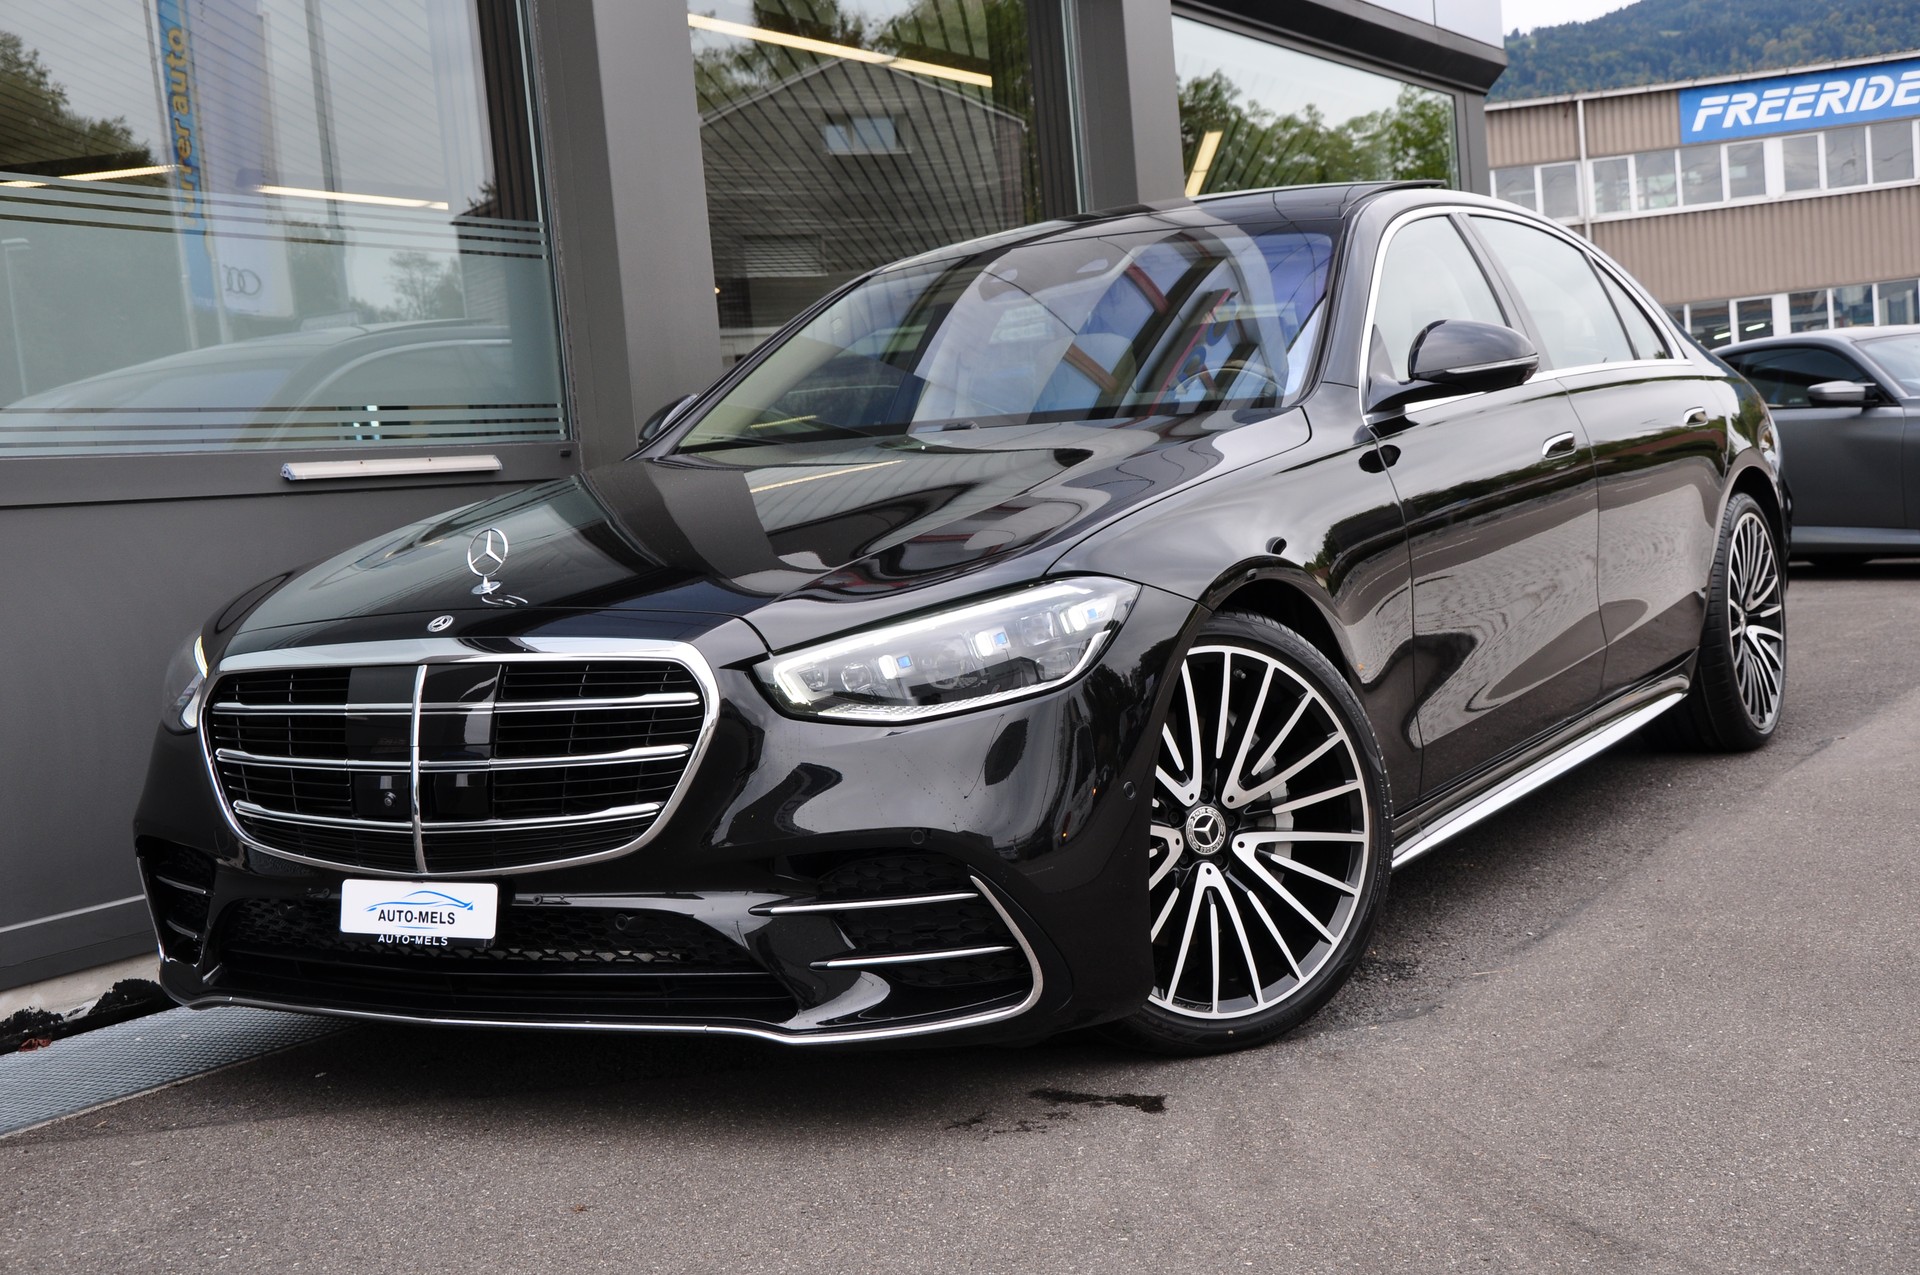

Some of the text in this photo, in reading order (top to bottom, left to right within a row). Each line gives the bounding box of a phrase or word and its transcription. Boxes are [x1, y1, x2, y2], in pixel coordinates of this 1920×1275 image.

[1691, 69, 1920, 132] FREERIDE
[378, 909, 456, 925] AUTO-MELS
[377, 933, 449, 946] AUTO-MELS
